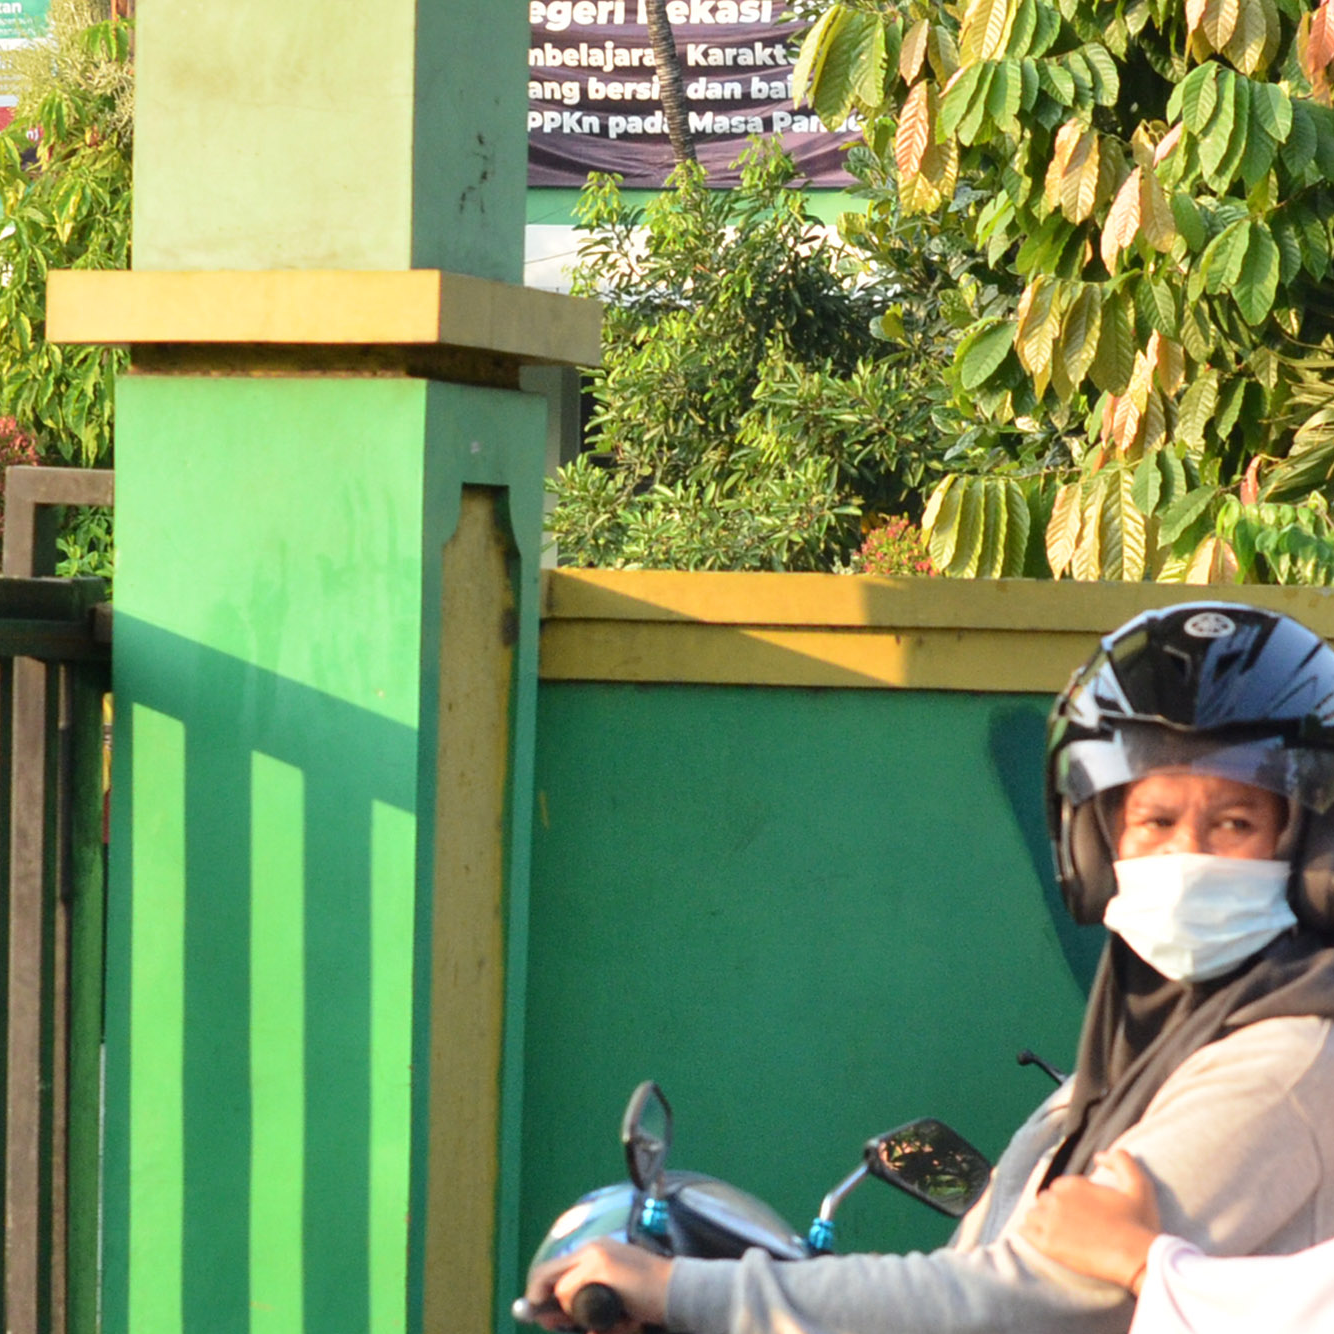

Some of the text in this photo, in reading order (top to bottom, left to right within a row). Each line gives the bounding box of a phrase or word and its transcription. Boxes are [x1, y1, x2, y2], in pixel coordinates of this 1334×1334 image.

[528, 41, 803, 72] mbelajara Karakte
[588, 75, 661, 100] bersi
[686, 77, 742, 100] dan
[751, 74, 795, 100] bai
[527, 111, 600, 133] PPKn
[688, 111, 764, 133] Masa
